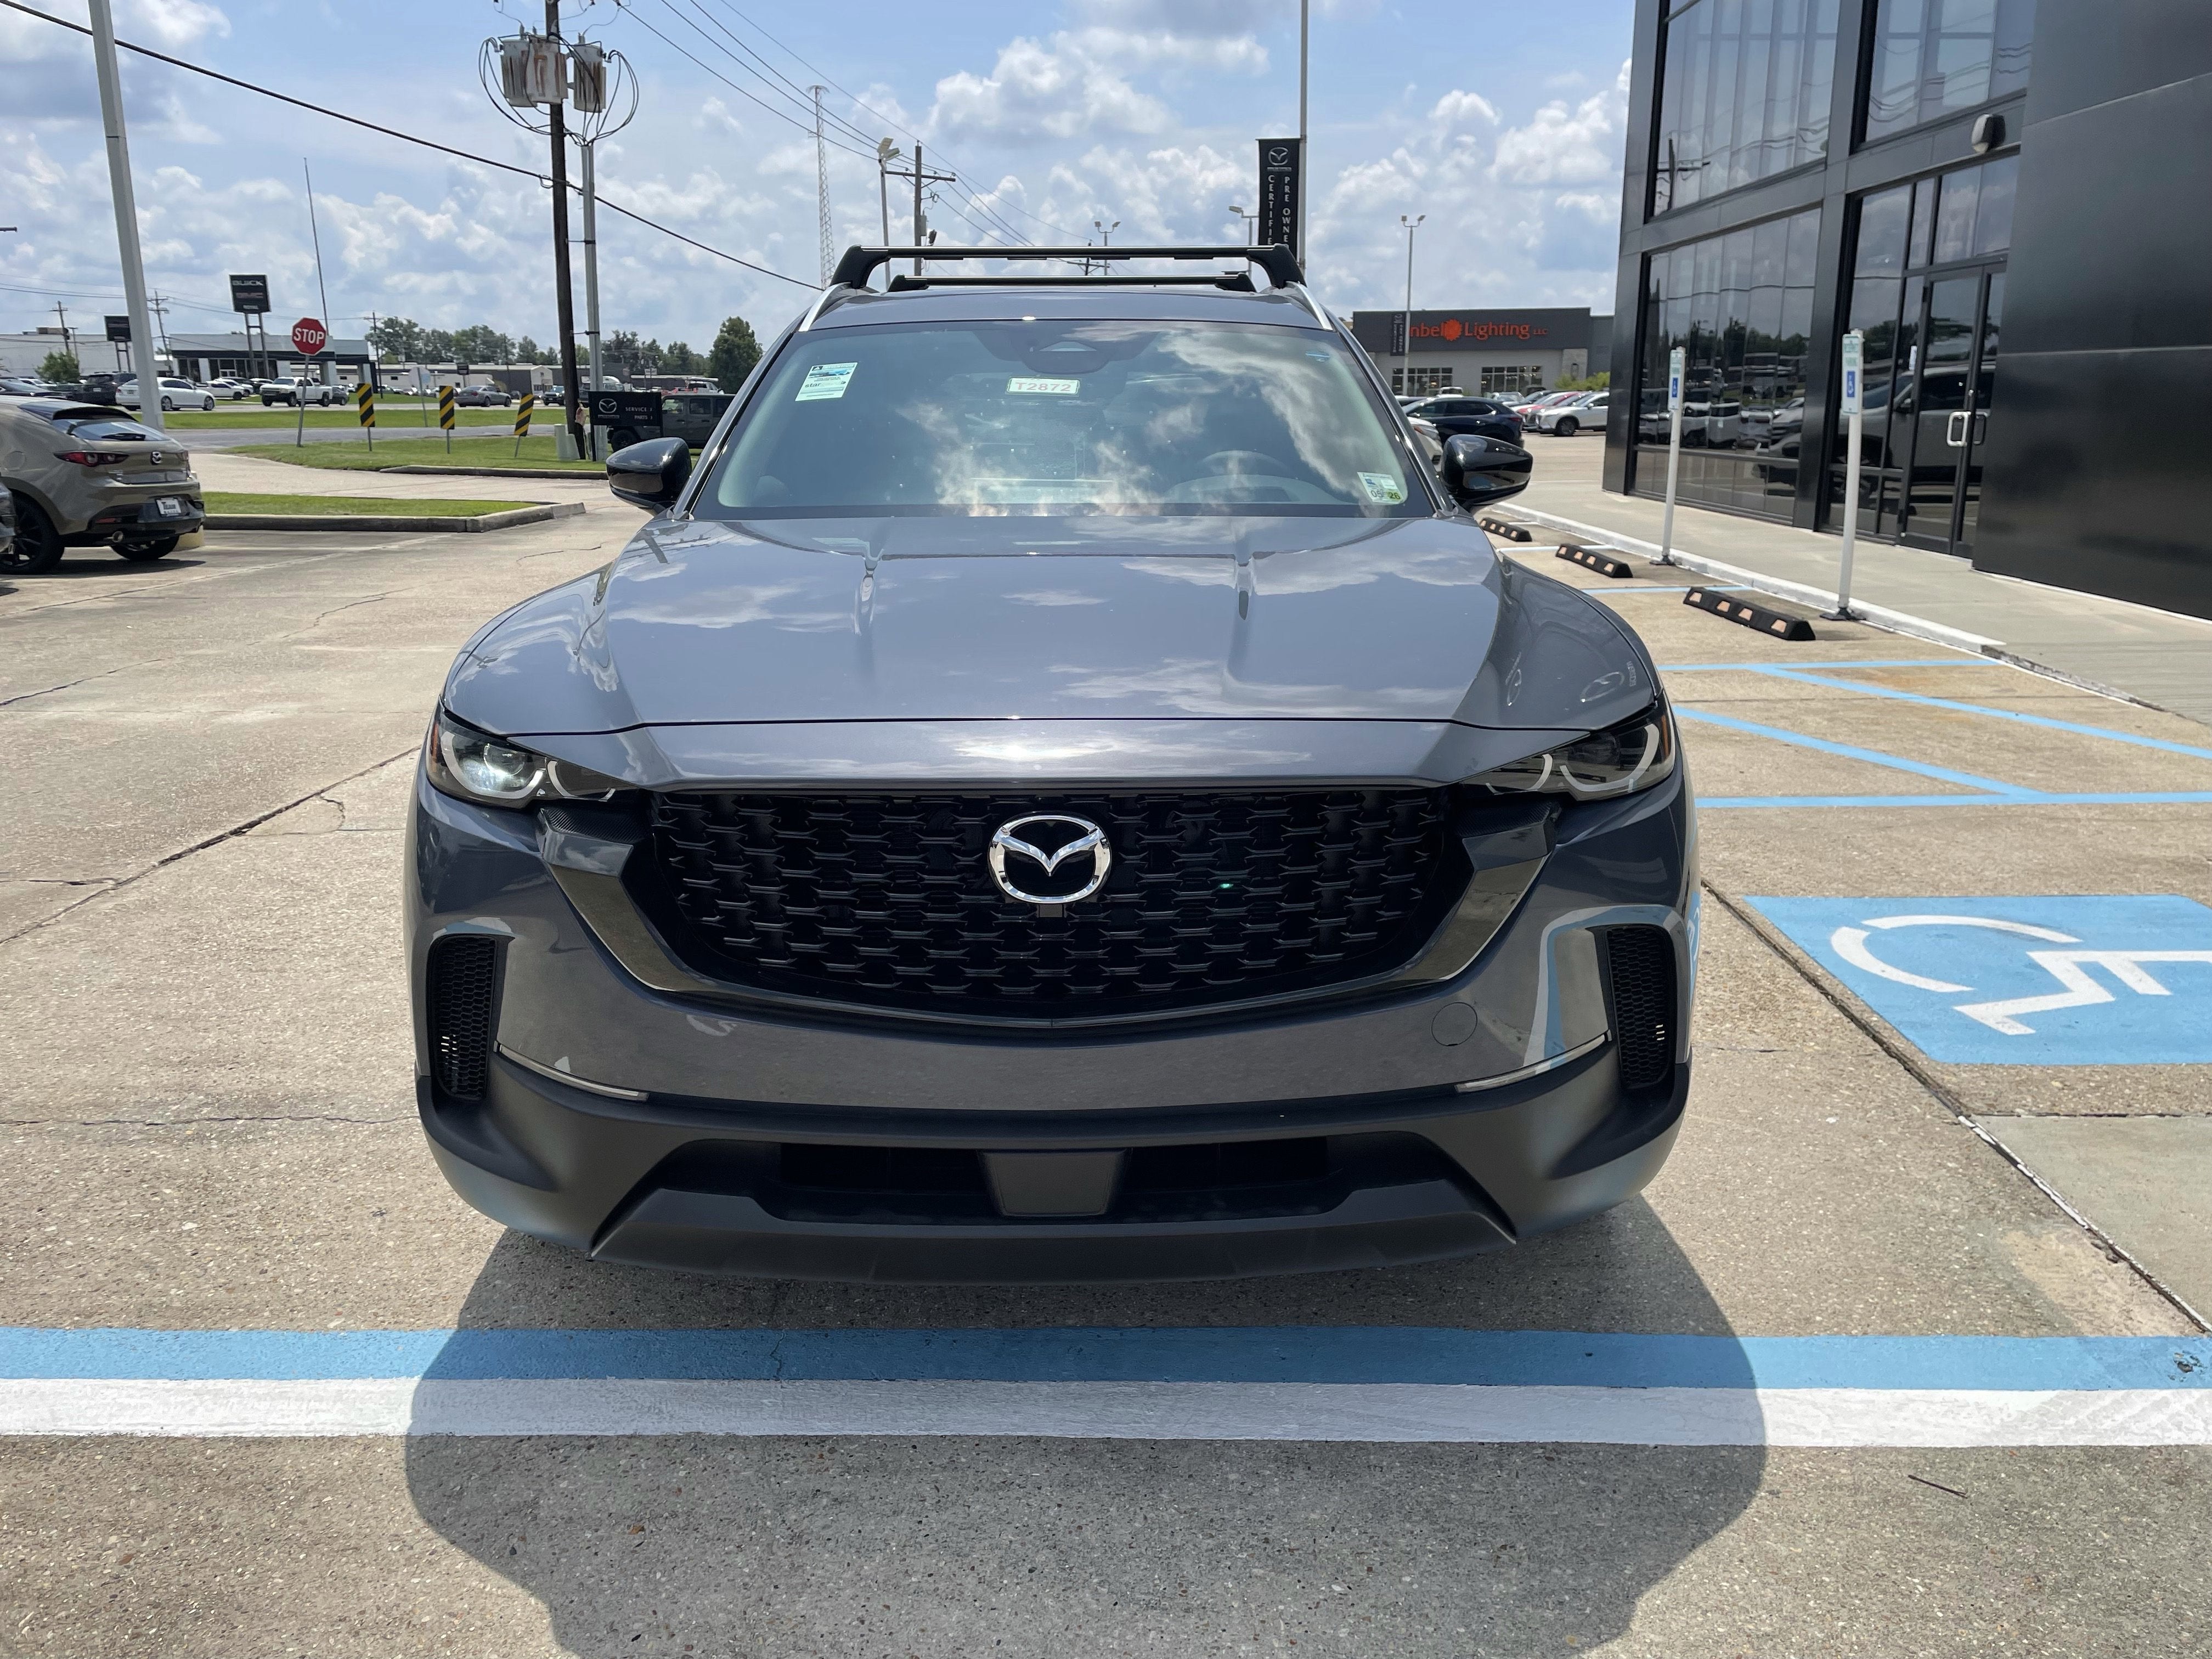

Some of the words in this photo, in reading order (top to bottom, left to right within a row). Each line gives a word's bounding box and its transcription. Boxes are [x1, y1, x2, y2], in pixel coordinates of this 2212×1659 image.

[1267, 174, 1276, 245] CERTIFIE
[1282, 208, 1291, 242] OWNE
[294, 327, 325, 345] STOP
[1409, 321, 1444, 337] nbel
[1464, 321, 1531, 341] Lighting
[1015, 382, 1071, 392] T2872
[1388, 492, 1401, 500] 26
